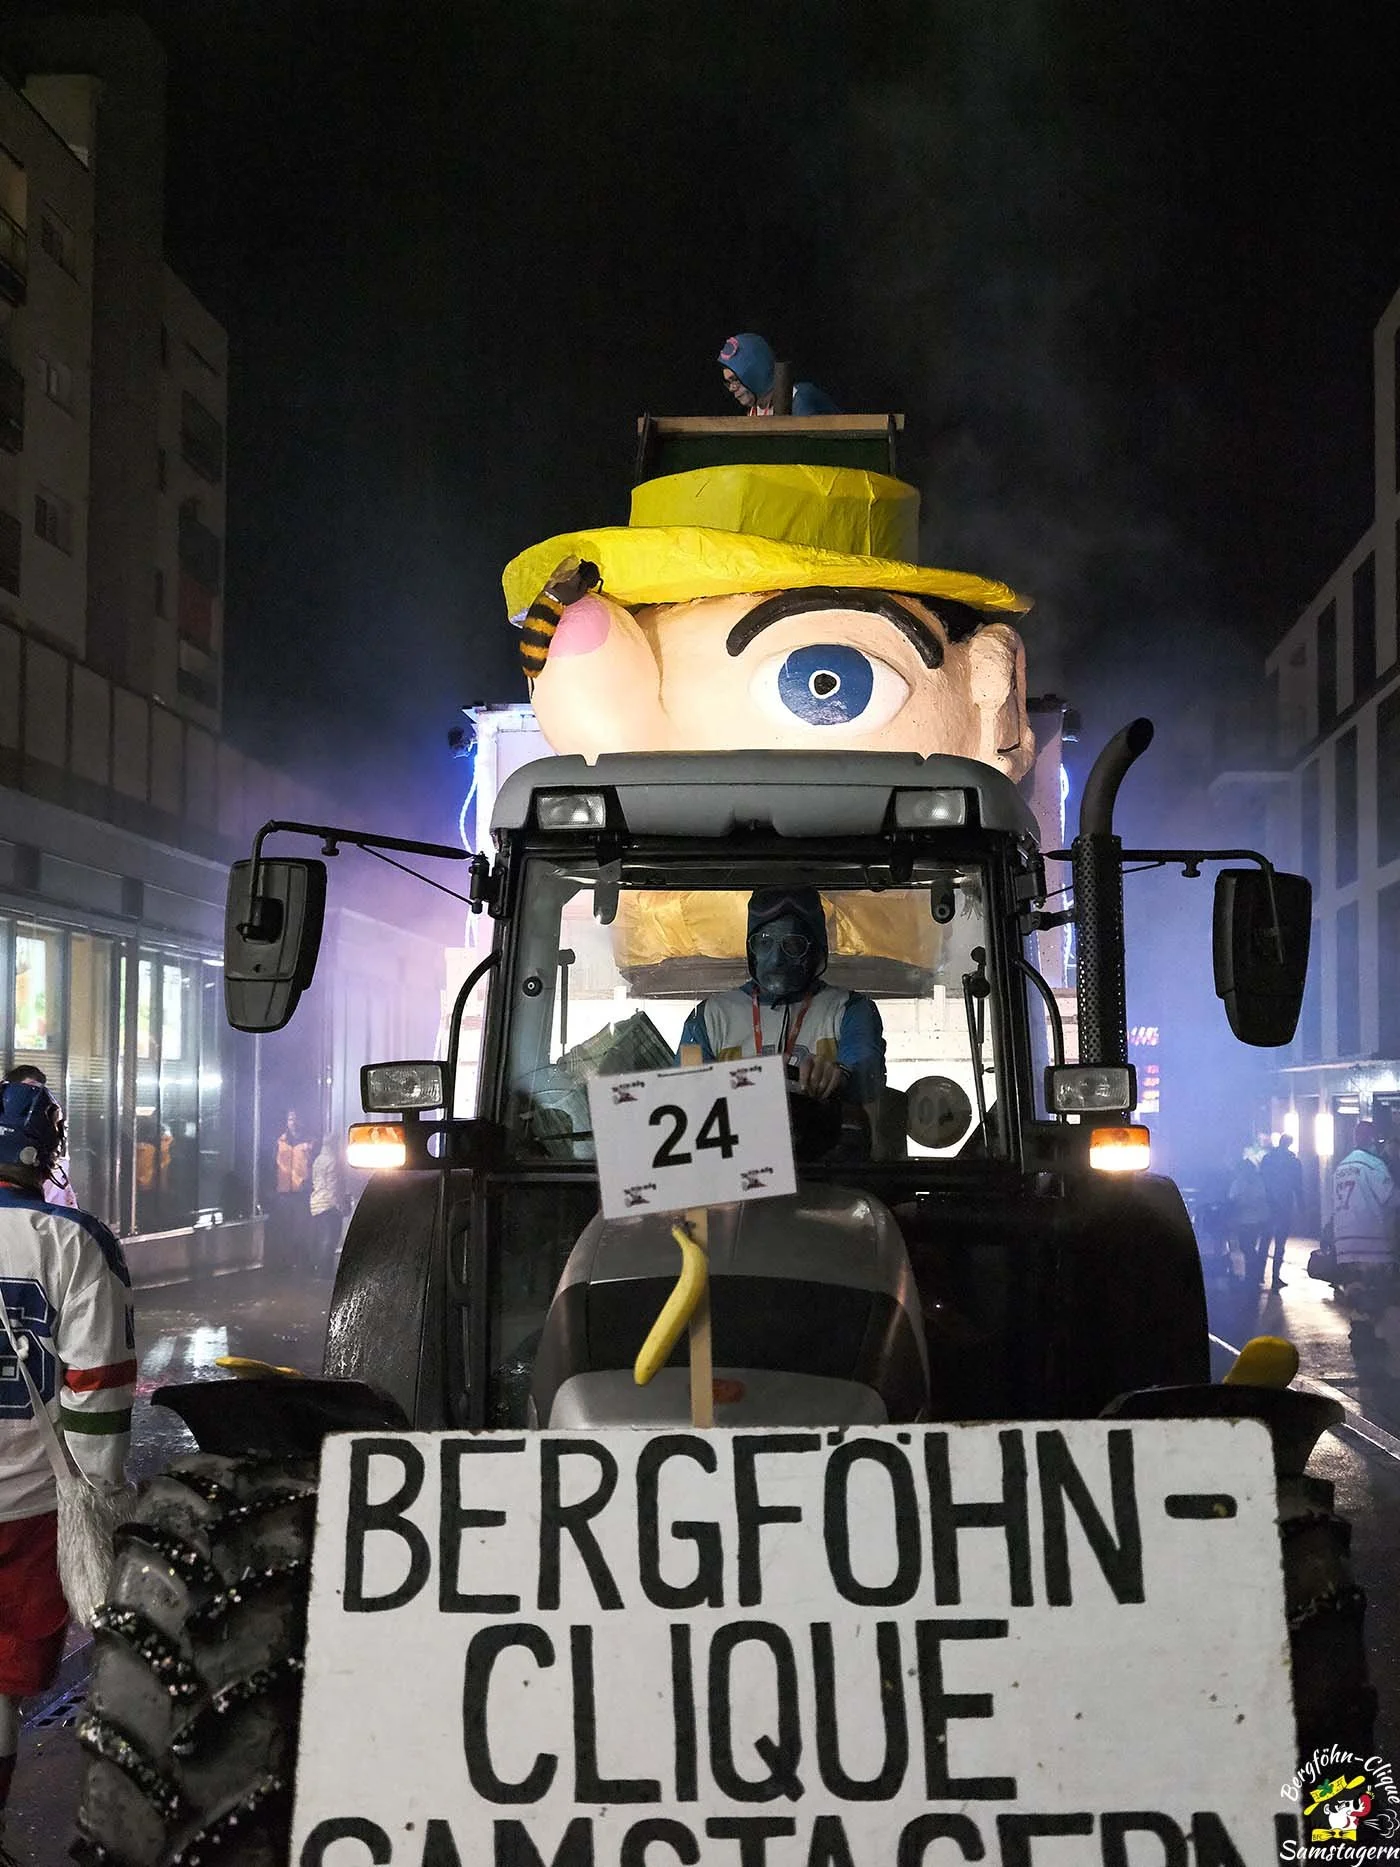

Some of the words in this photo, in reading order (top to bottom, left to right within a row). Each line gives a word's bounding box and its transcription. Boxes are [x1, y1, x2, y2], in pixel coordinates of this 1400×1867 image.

[648, 1096, 739, 1169] 24
[343, 1427, 1238, 1614] BERGFÖHN-
[463, 1619, 1017, 1804] CLIQUE
